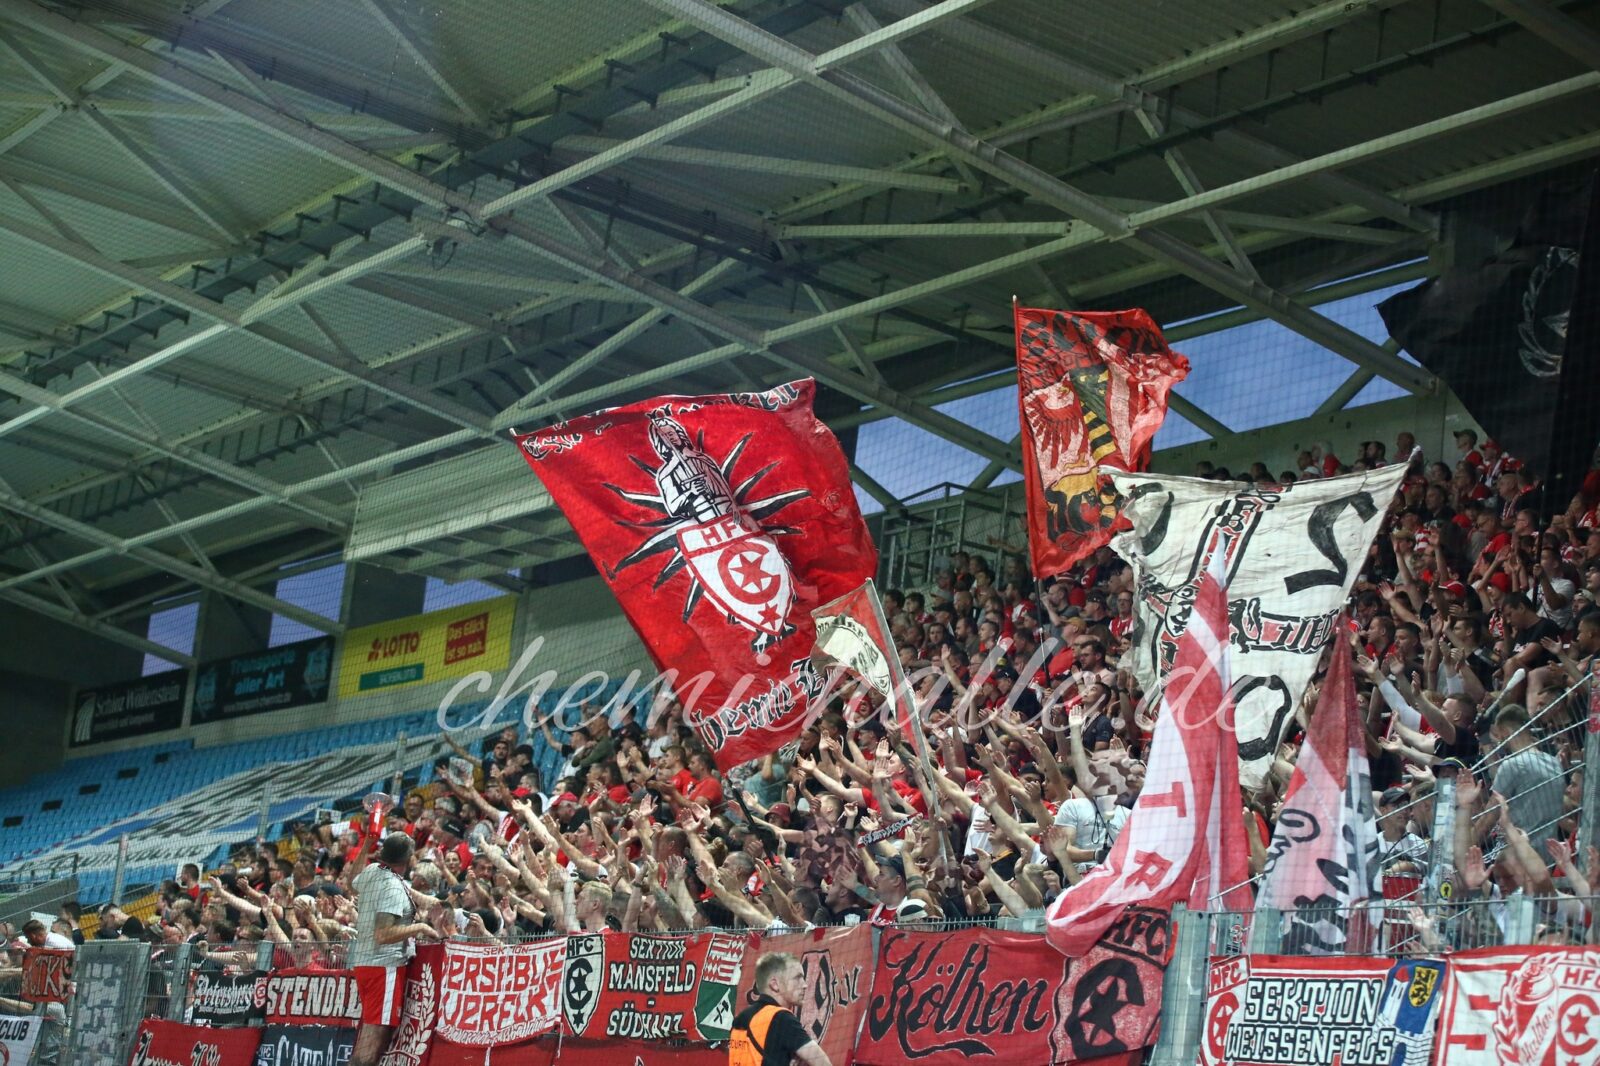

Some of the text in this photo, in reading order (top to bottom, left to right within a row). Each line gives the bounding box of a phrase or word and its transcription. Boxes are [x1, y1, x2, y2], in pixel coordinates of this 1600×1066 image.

[383, 632, 420, 658] LOTTO
[235, 671, 285, 696] aller Art
[567, 937, 595, 956] HFC
[630, 936, 687, 959] SEKTION
[608, 963, 696, 993] MANSFELD
[1210, 961, 1241, 991] HFC
[266, 975, 362, 1019] STENDAL
[868, 932, 1049, 1058] Köthen
[1245, 979, 1383, 1024] SEKTION
[606, 1003, 687, 1039] SÜDHARZ
[1225, 1024, 1396, 1066] WEISSENFELS
